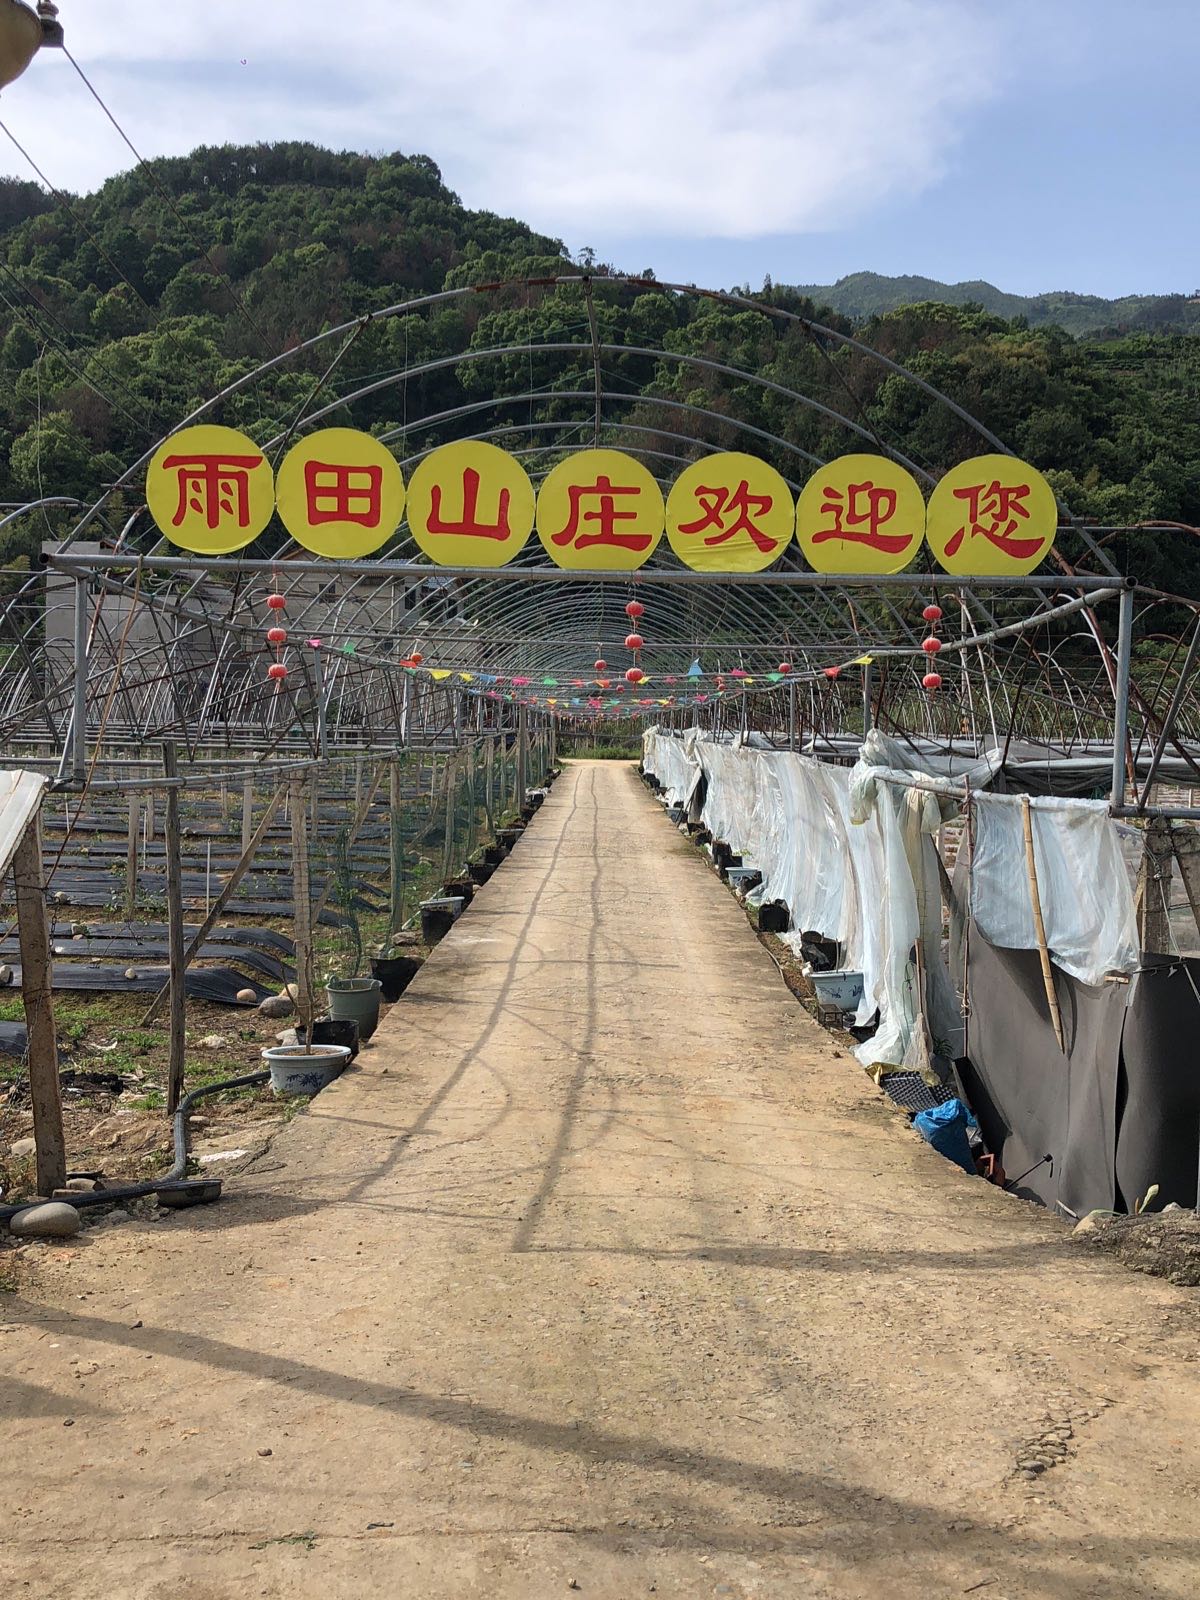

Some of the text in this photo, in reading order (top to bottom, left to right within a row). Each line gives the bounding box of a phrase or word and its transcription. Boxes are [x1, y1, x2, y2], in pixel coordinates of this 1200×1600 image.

[162, 455, 1044, 559] 雨田山庄欢迎您
